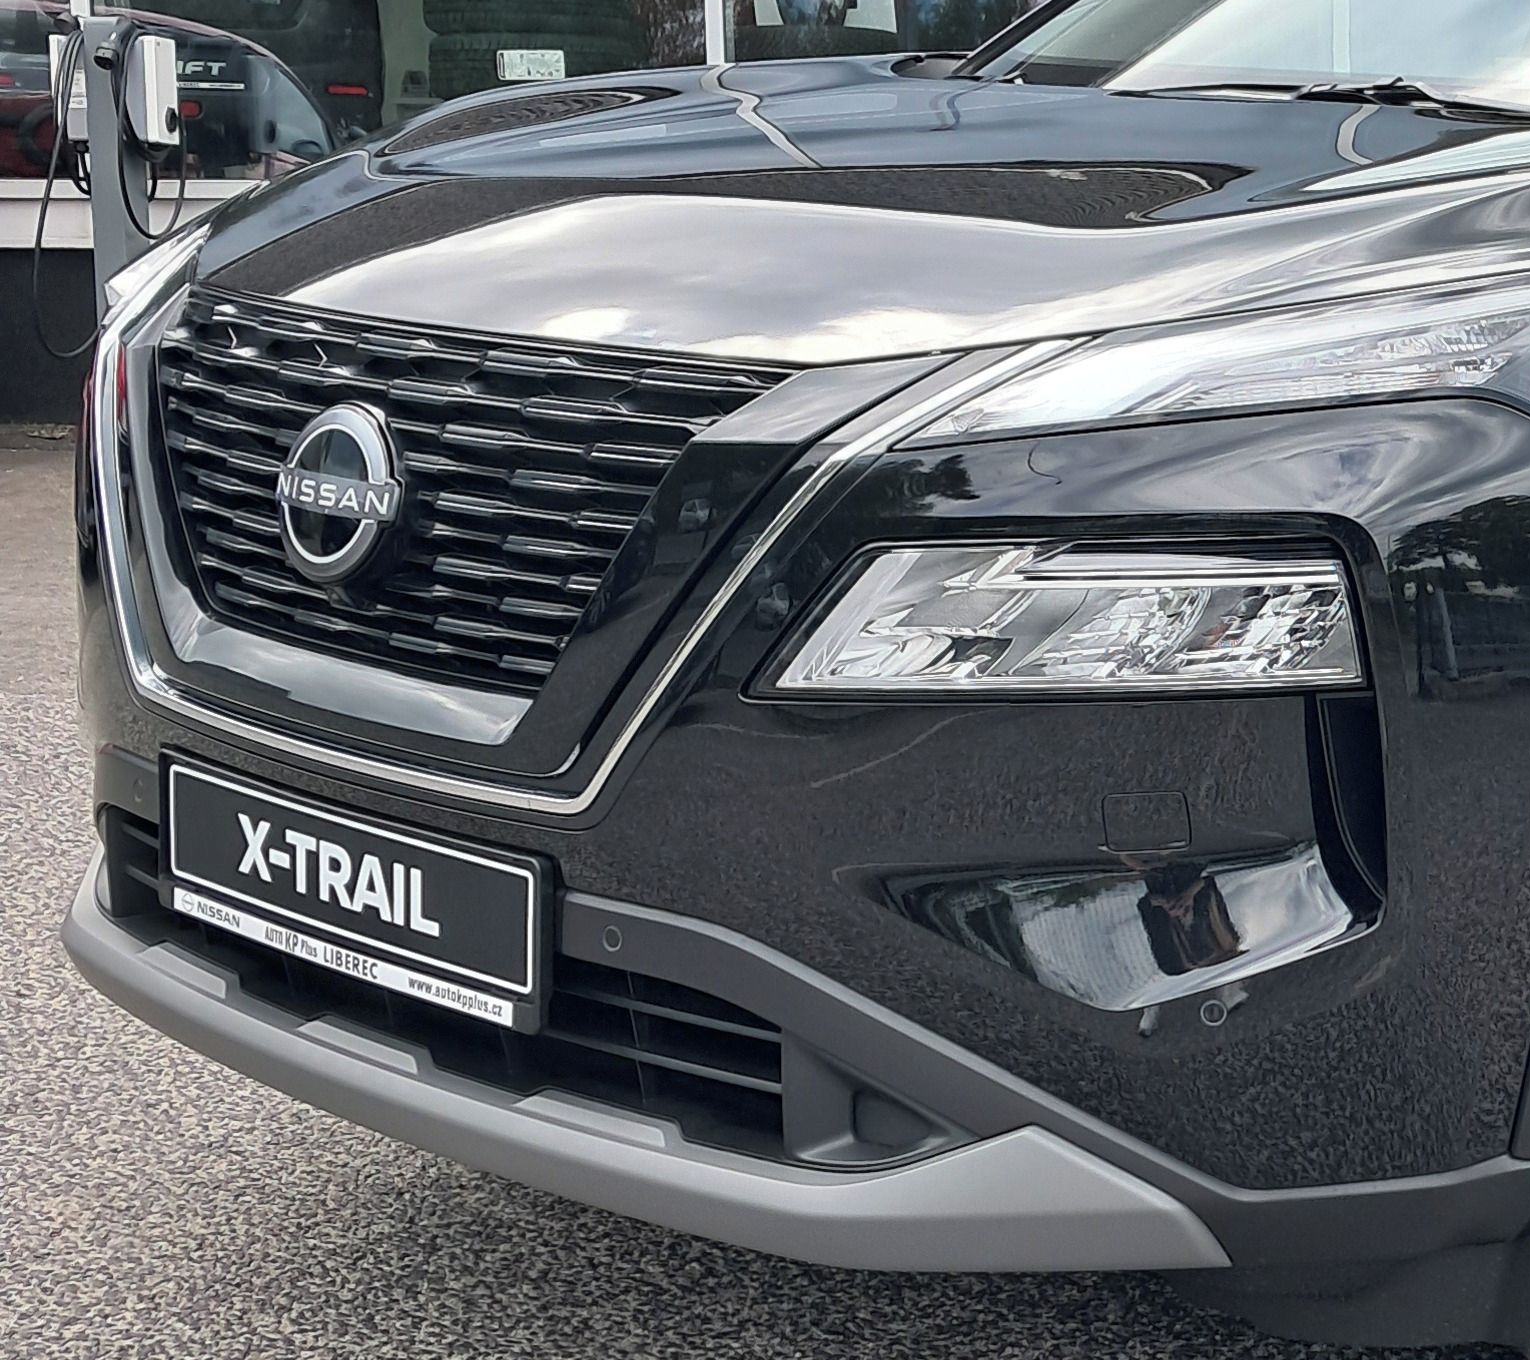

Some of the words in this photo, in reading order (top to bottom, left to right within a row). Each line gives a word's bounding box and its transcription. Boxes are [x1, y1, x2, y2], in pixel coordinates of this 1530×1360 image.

[176, 60, 227, 76] IFT
[276, 472, 390, 515] NISSAN
[237, 812, 440, 938] X-TRAIL
[196, 900, 241, 929] NISSAN
[264, 926, 283, 945] AUTO
[284, 930, 299, 953] KP
[300, 938, 318, 958] Plus
[323, 947, 379, 980] LIBEREC
[407, 976, 503, 1017] www.autokpplus.cz
